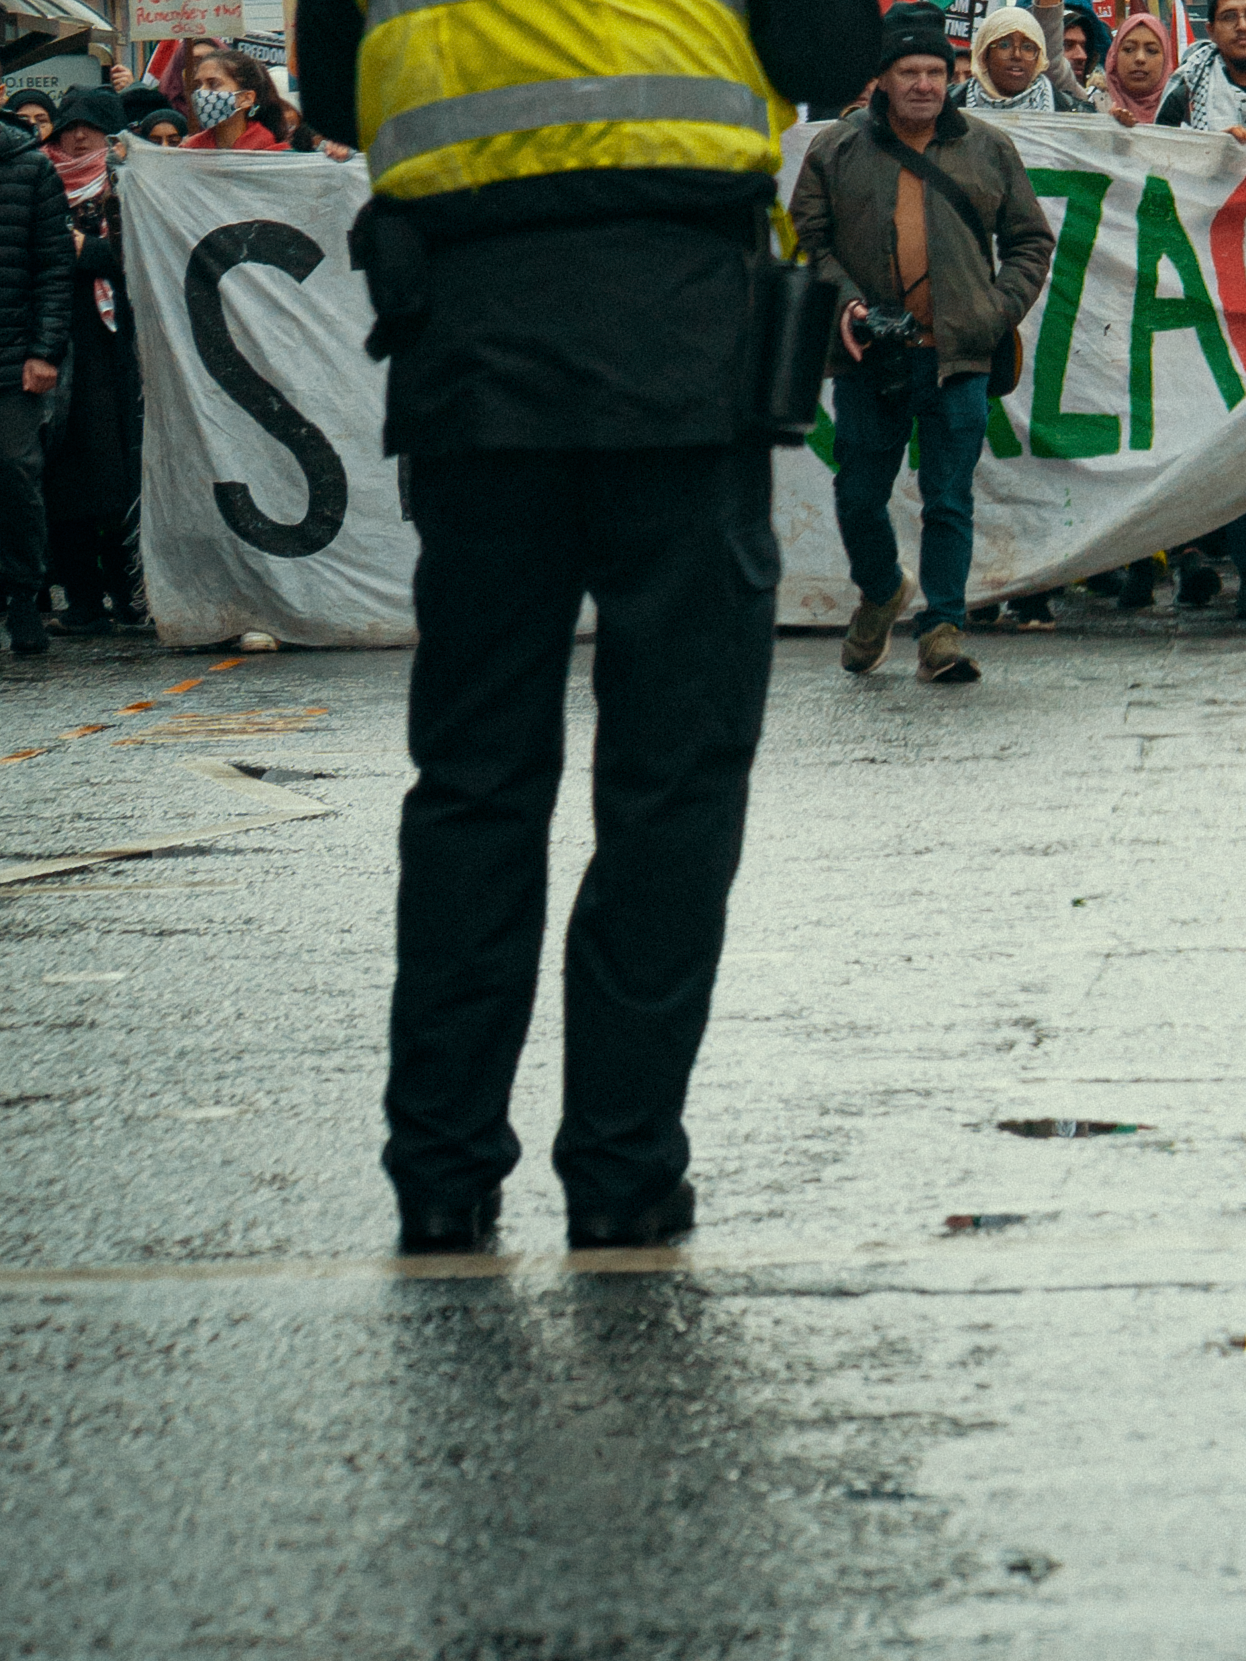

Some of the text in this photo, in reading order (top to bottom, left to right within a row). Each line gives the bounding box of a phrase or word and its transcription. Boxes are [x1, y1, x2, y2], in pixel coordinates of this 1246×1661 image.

[136, 1, 208, 26] Remember
[170, 21, 206, 35] day
[237, 41, 286, 65] FREEDOM
[2, 76, 59, 88] O.1 BEER
